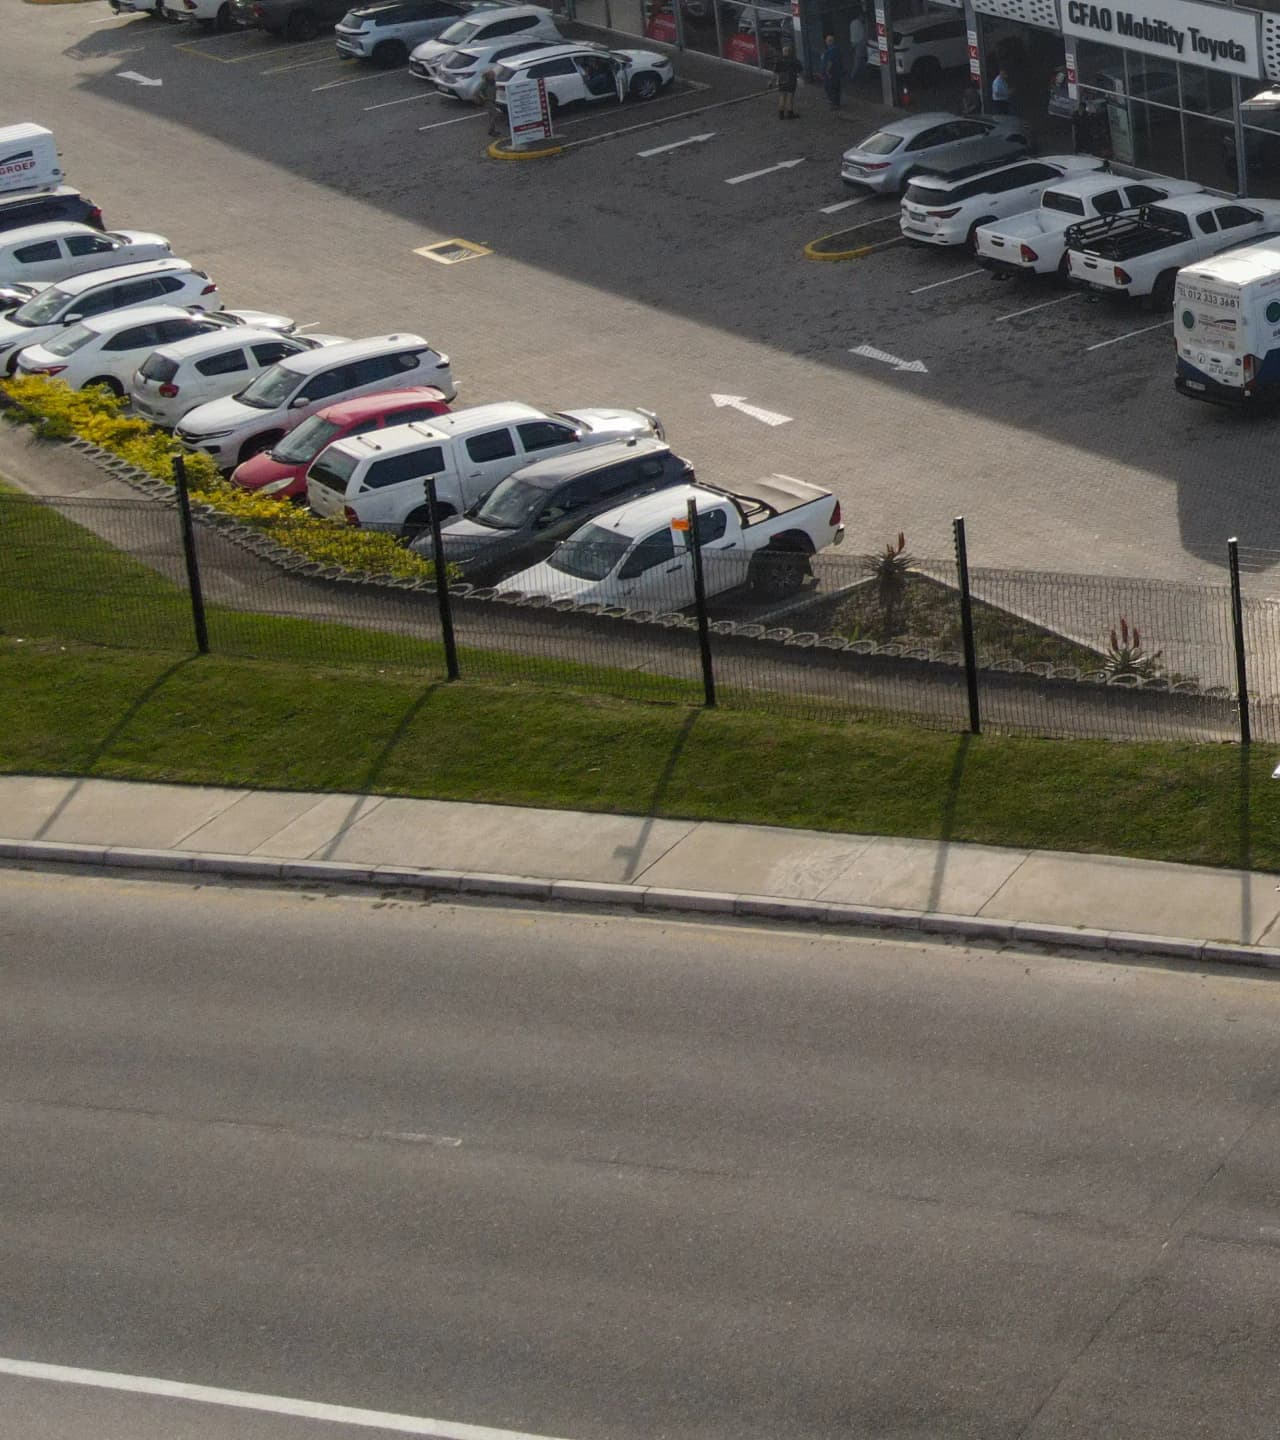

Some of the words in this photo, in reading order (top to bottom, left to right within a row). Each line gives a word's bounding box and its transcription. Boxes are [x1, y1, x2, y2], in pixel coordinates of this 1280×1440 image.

[1068, 0, 1112, 32] CFAO
[1116, 11, 1184, 54] Mobility
[1187, 26, 1246, 63] Toyota
[1188, 289, 1201, 300] 012
